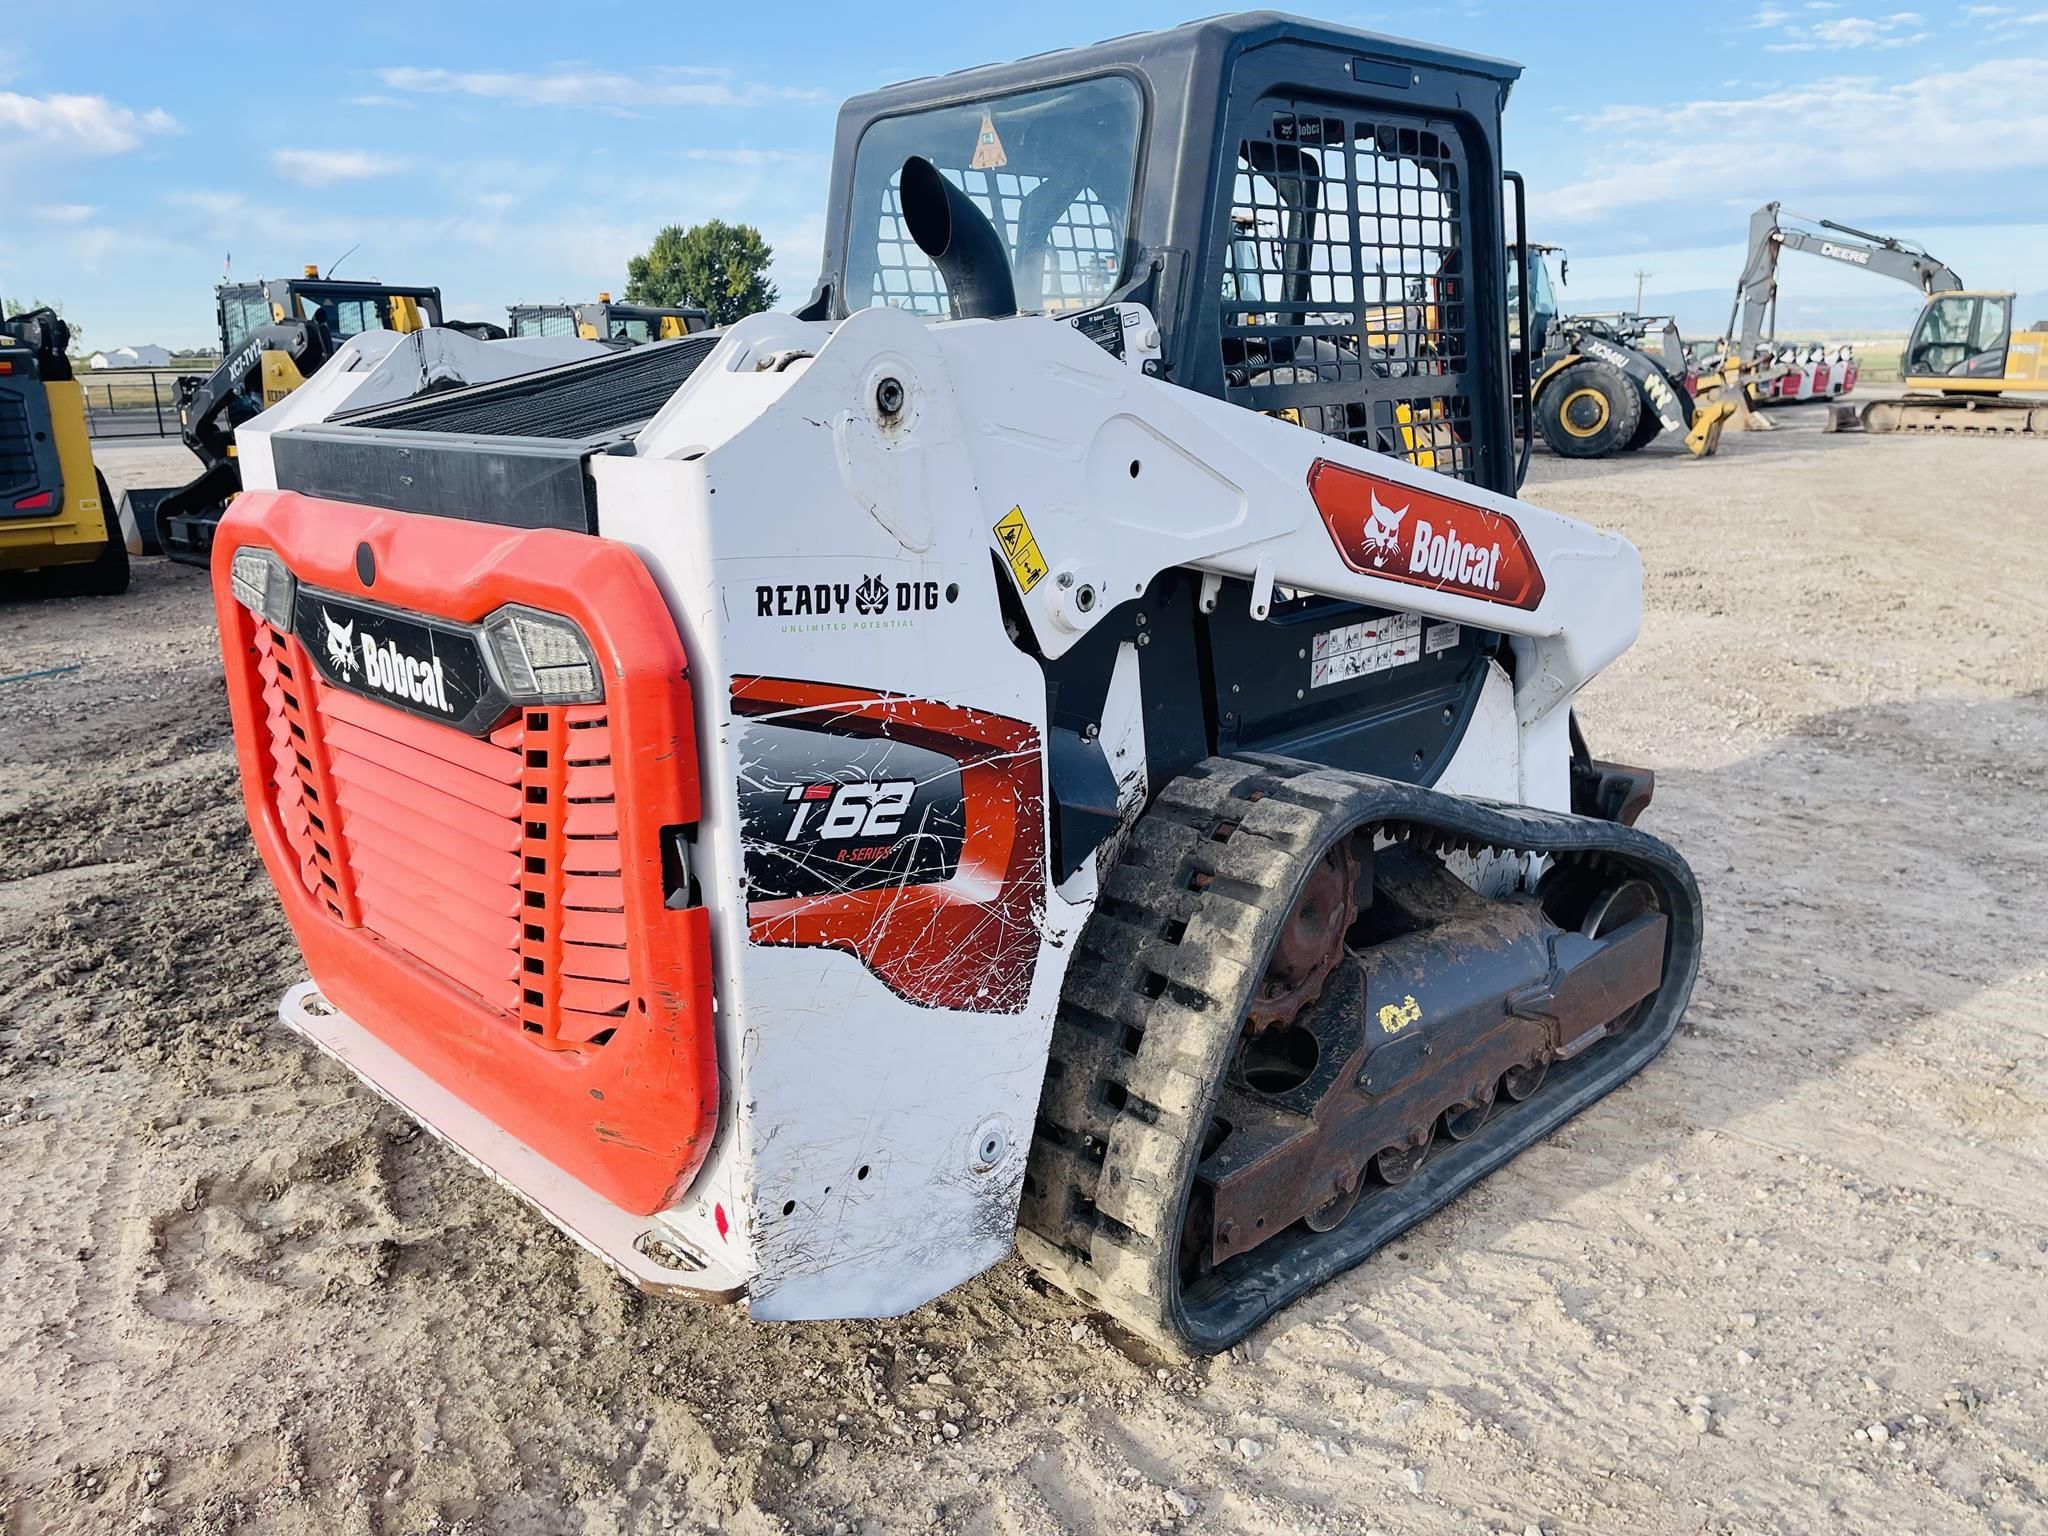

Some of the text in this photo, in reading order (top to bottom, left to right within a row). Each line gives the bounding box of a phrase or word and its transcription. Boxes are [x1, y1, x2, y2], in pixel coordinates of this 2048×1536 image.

[1821, 242, 1870, 264] DEERE
[228, 338, 263, 382] XC7-TV12
[1409, 519, 1500, 591] Bobcat
[755, 581, 939, 617] READY DIG
[781, 619, 915, 633] UNLIMITED POTENTIAL
[360, 632, 449, 712] Bobcat
[784, 781, 915, 841] T62
[836, 845, 892, 862] R-SERIES
